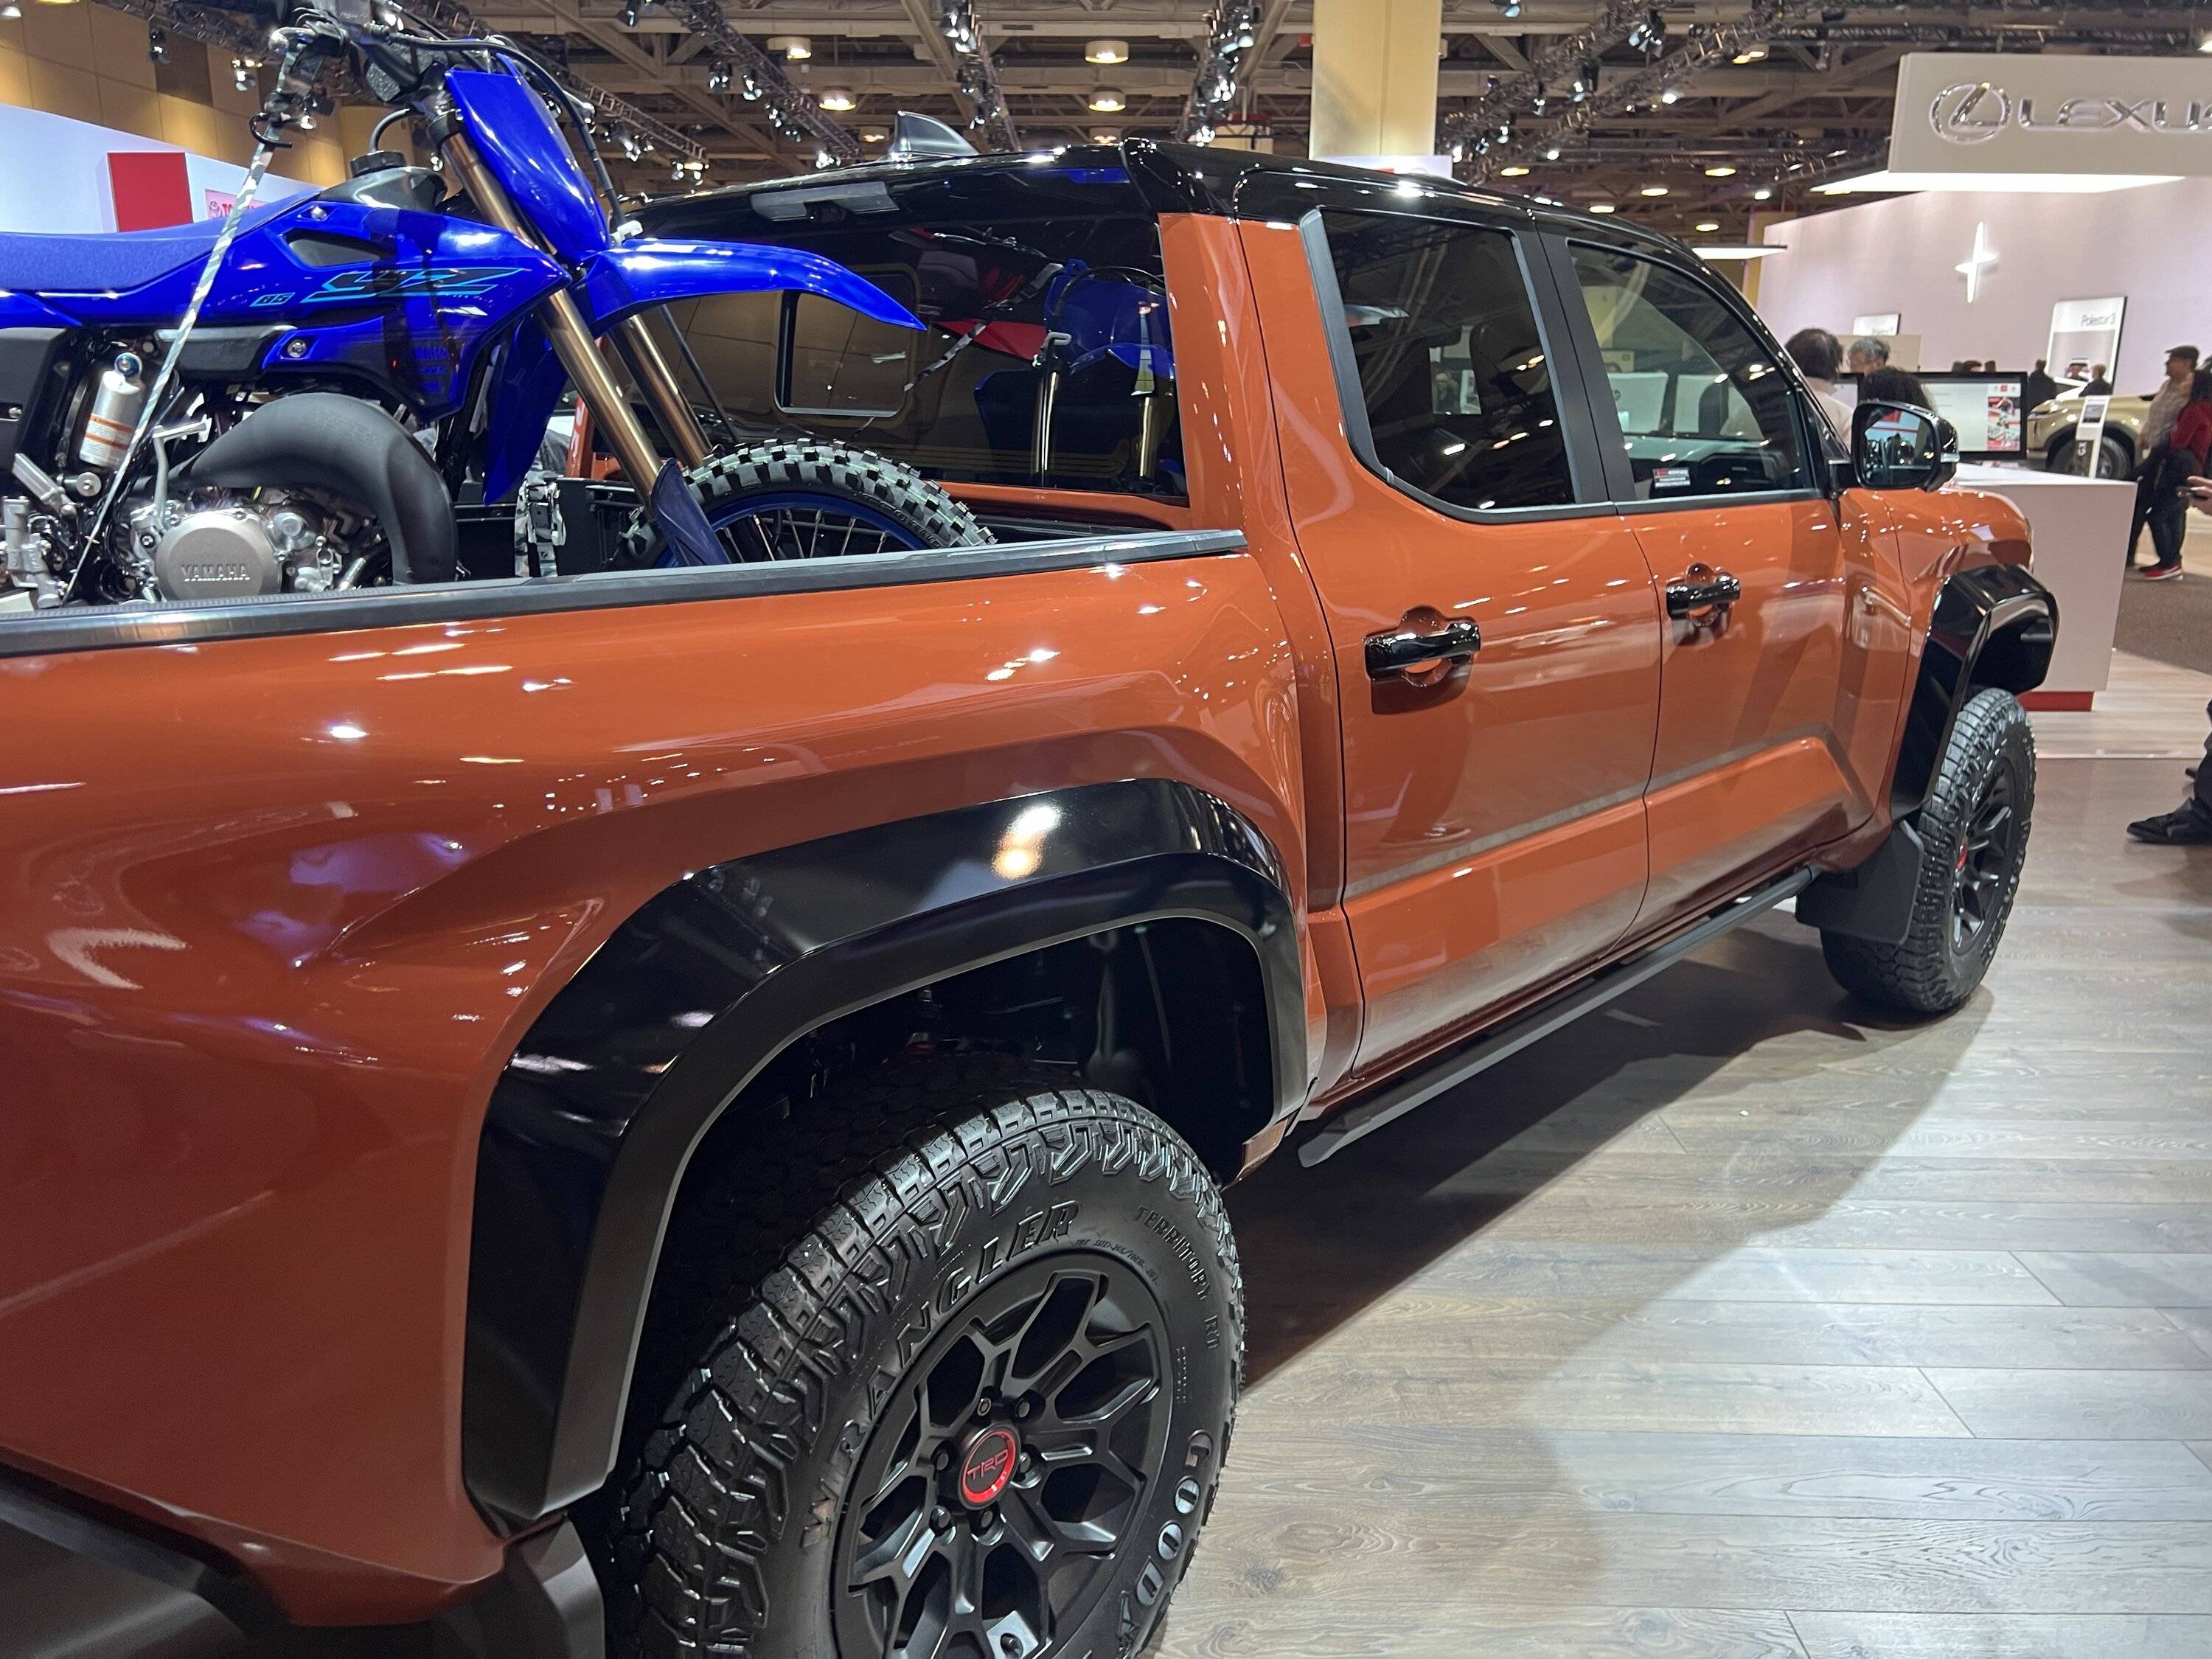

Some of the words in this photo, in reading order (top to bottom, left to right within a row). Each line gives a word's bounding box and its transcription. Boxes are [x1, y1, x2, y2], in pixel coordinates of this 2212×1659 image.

[2018, 97, 2212, 133] LEXU
[251, 293, 293, 306] 85
[300, 267, 524, 303] YZ
[180, 563, 250, 581] YAMAHA
[1133, 1205, 1213, 1301] TERRITORY
[802, 1199, 1079, 1548] WRANGLER
[967, 1449, 1008, 1480] TRD
